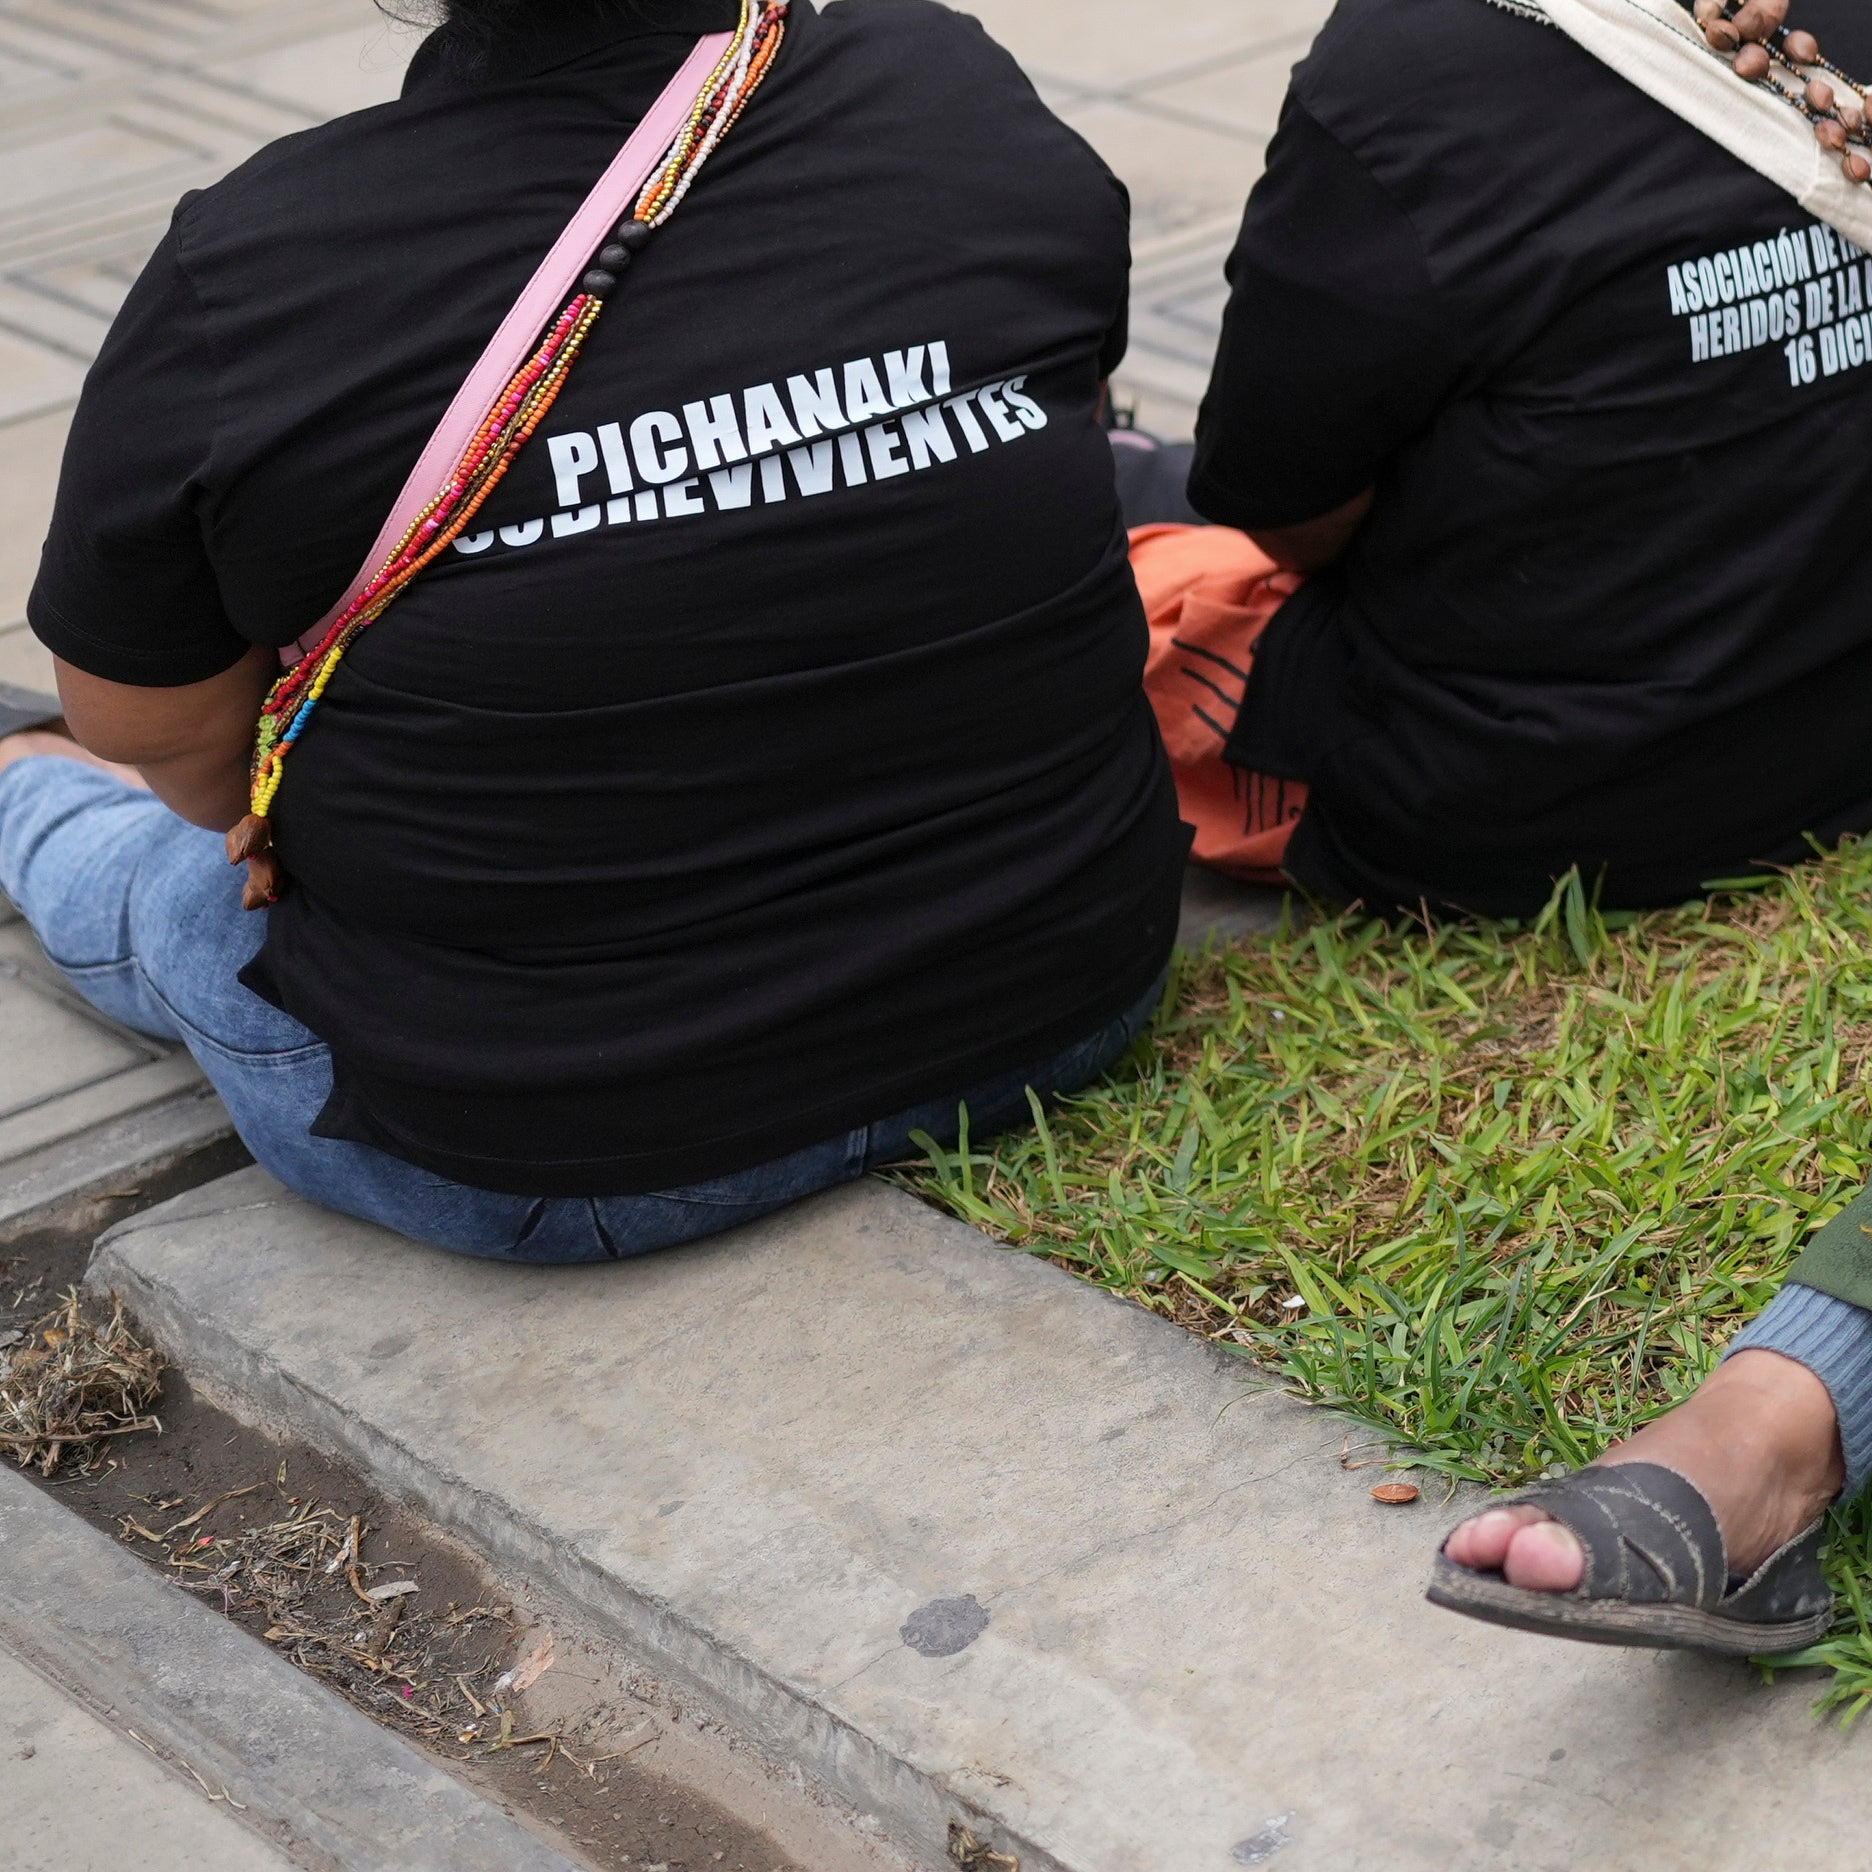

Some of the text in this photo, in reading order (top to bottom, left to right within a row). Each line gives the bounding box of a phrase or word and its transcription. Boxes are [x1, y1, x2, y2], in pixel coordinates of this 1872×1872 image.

[1667, 226, 1812, 316] ASOCIACIÓN
[1808, 222, 1839, 275] DE
[1689, 288, 1801, 363] HERIDOS
[1804, 276, 1834, 330] DE
[1836, 264, 1863, 318] LA
[1784, 334, 1817, 388] 16
[547, 340, 952, 507] PICHANAKI
